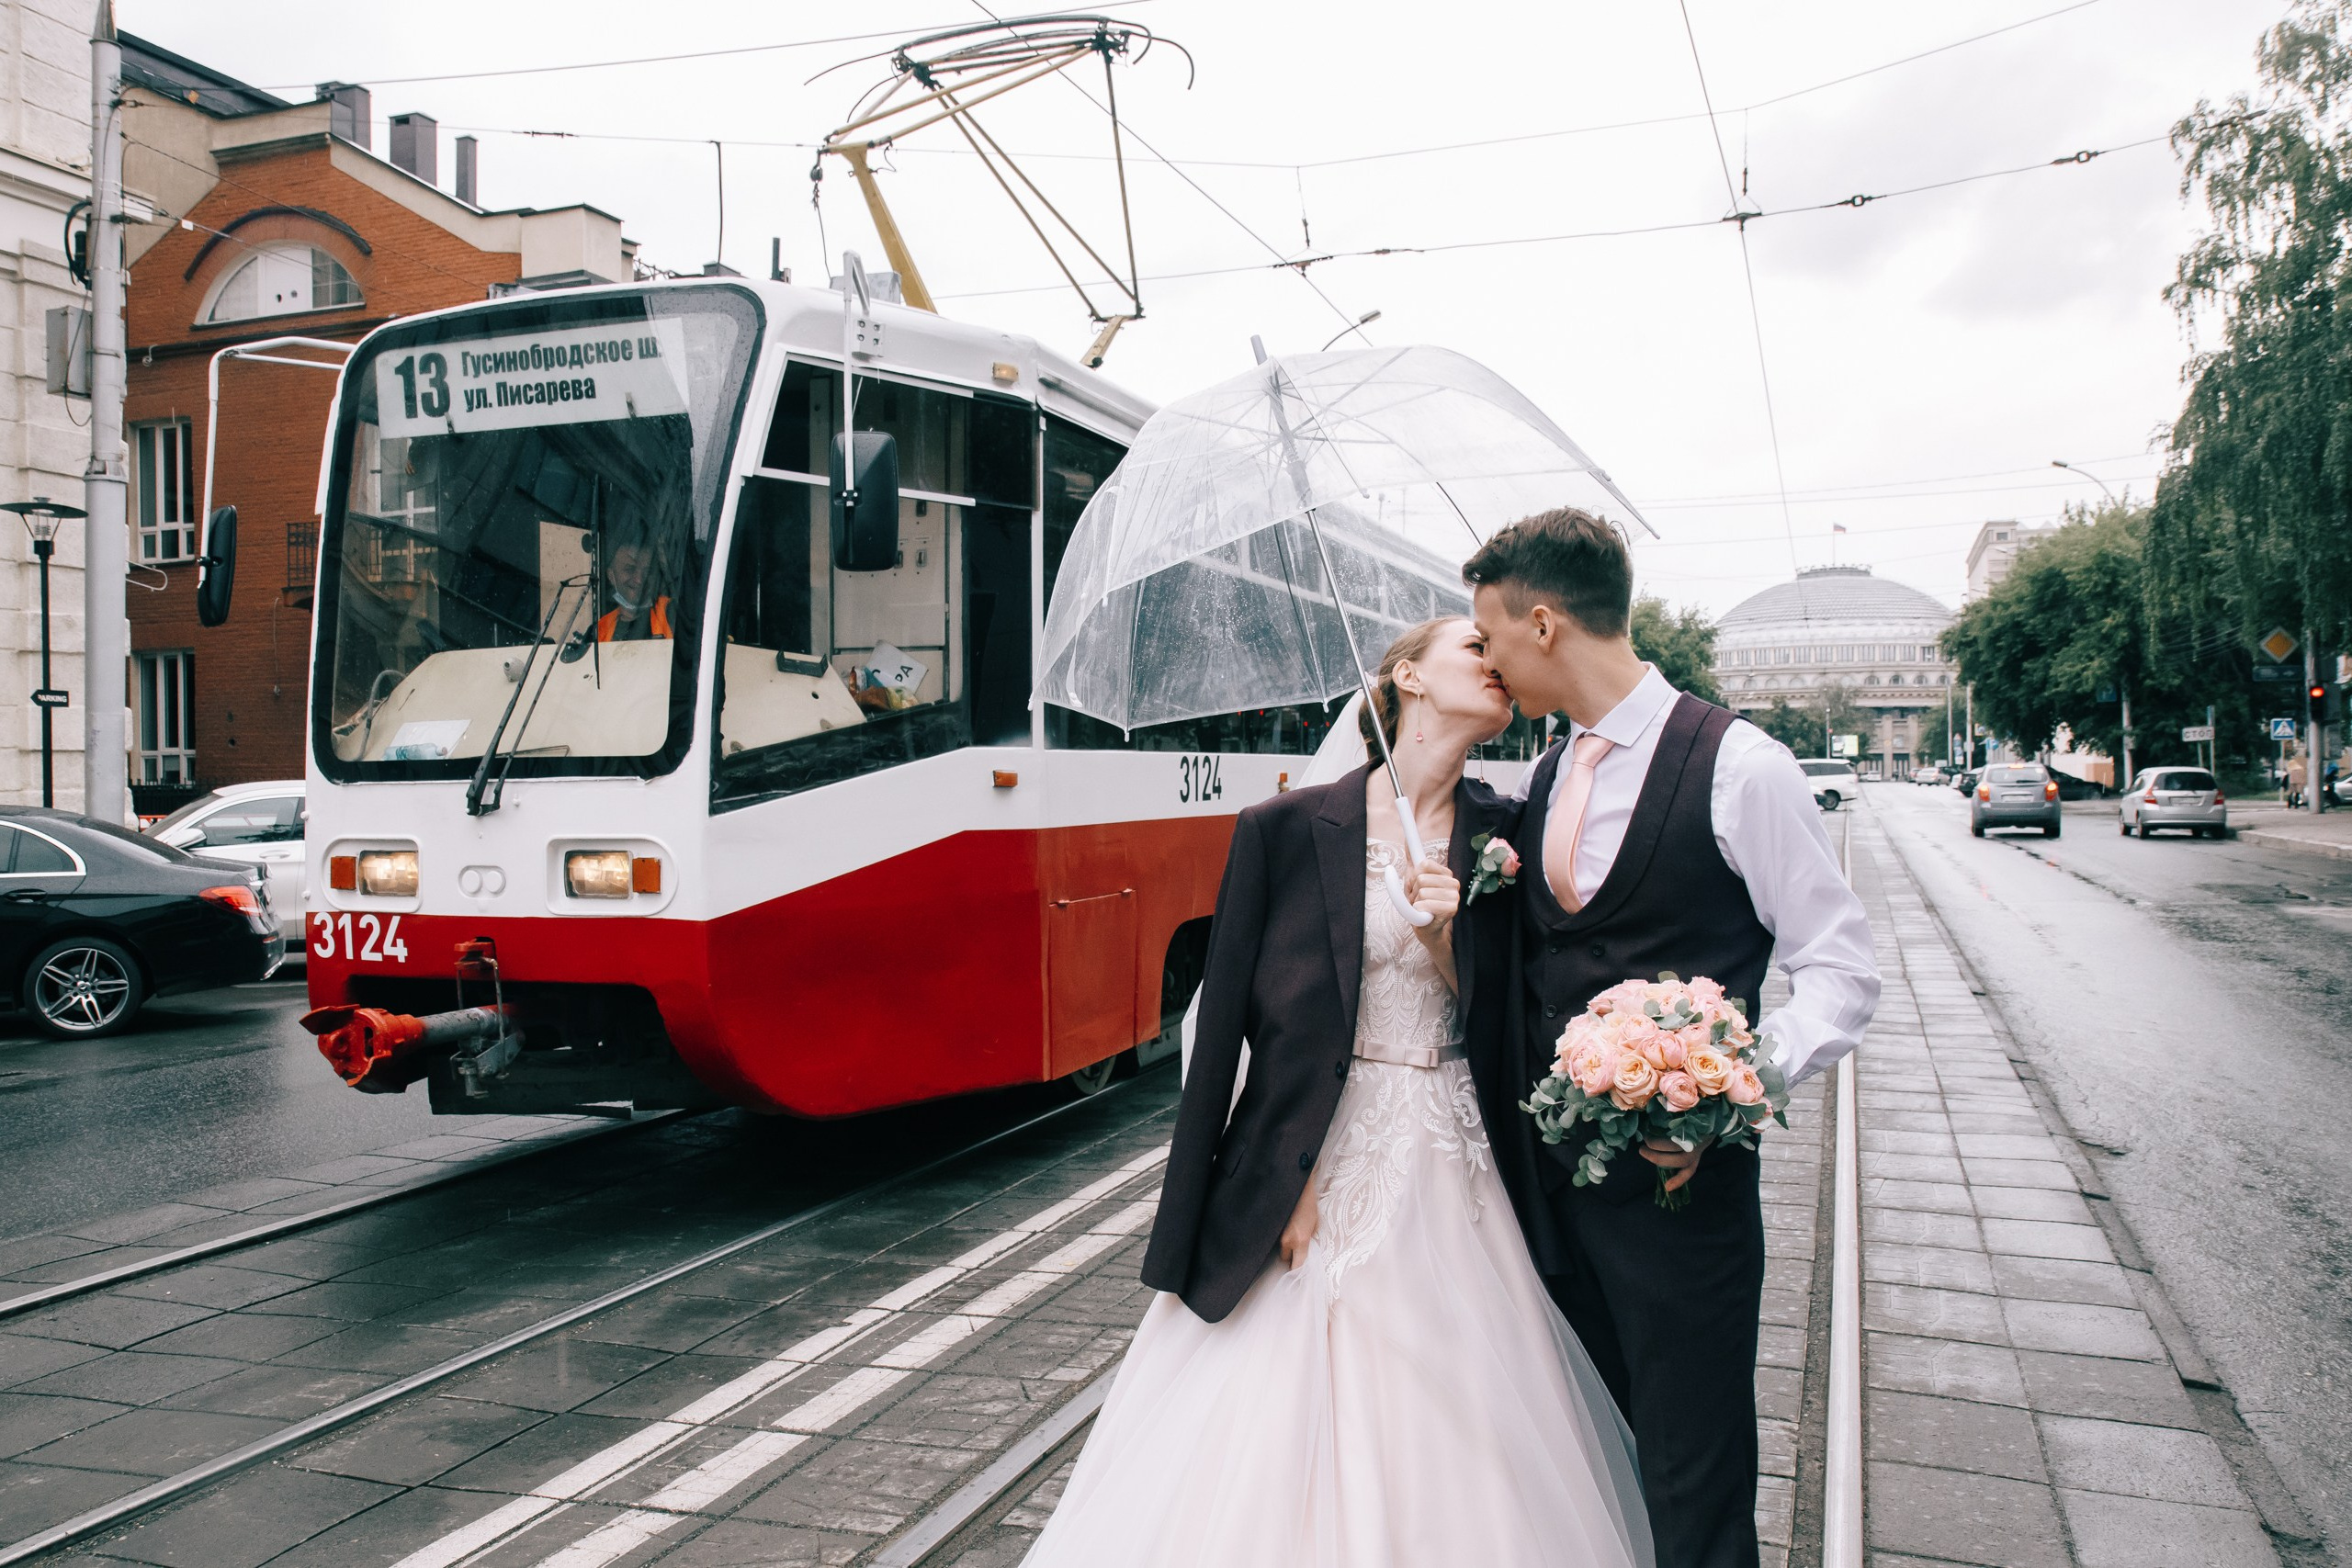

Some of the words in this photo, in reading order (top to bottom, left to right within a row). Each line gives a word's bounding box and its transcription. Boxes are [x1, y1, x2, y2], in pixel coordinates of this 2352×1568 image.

[461, 339, 633, 378] Гусинобродское
[395, 353, 450, 419] 13
[463, 388, 492, 413] ул.
[496, 378, 597, 408] Писарева
[37, 694, 68, 703] PARKING
[1180, 755, 1222, 803] 3124
[313, 911, 408, 963] 3124
